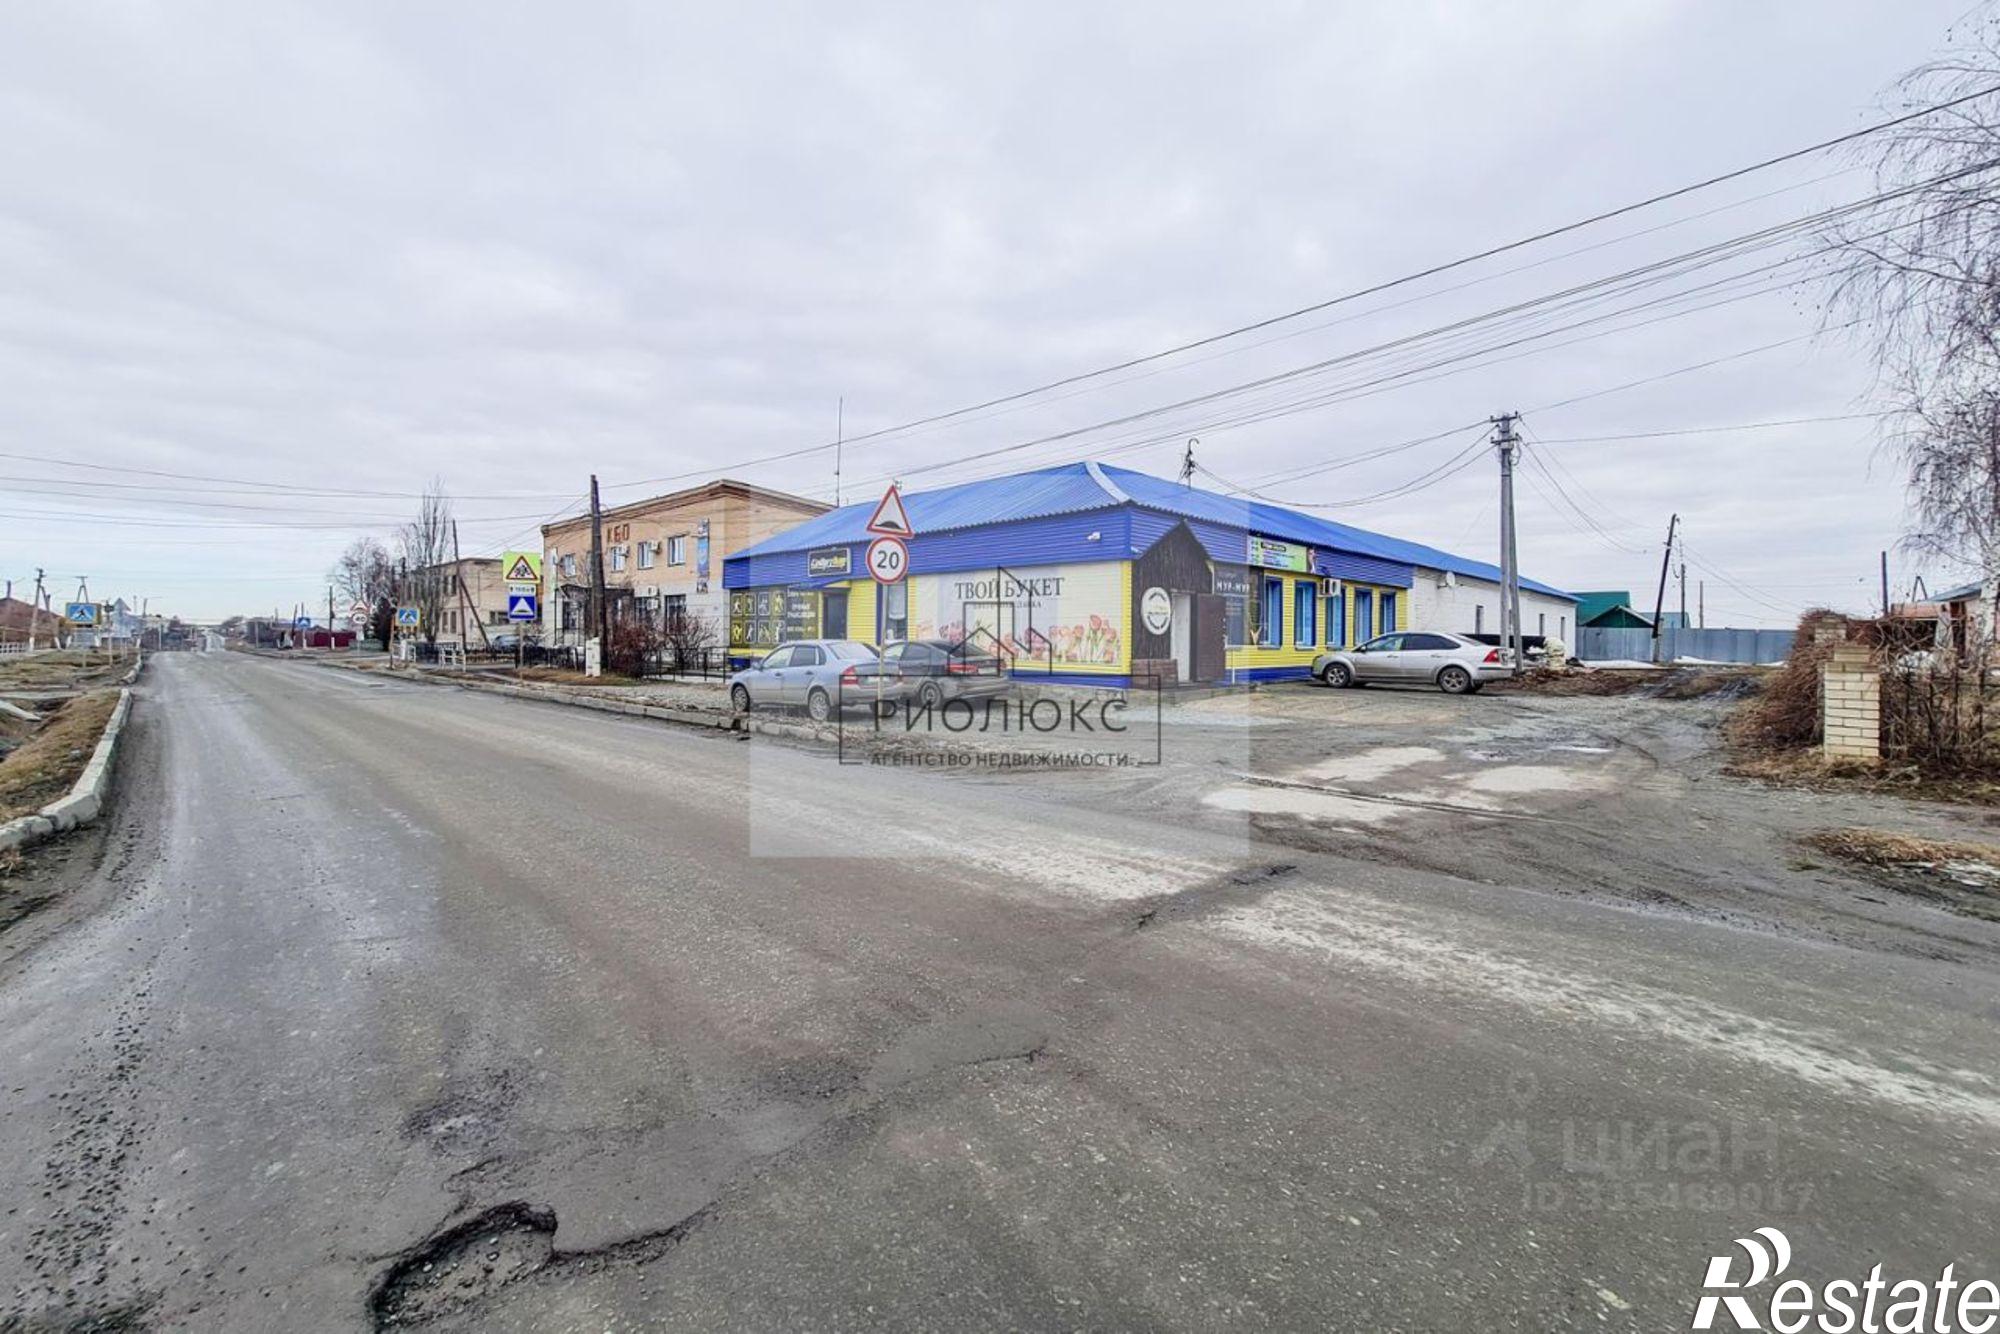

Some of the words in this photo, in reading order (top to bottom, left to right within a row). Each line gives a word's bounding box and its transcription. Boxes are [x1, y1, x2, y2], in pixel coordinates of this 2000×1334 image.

[876, 550, 901, 571] 20
[954, 579, 999, 599] ТВОЙ
[1005, 577, 1065, 598] БУКЕТ
